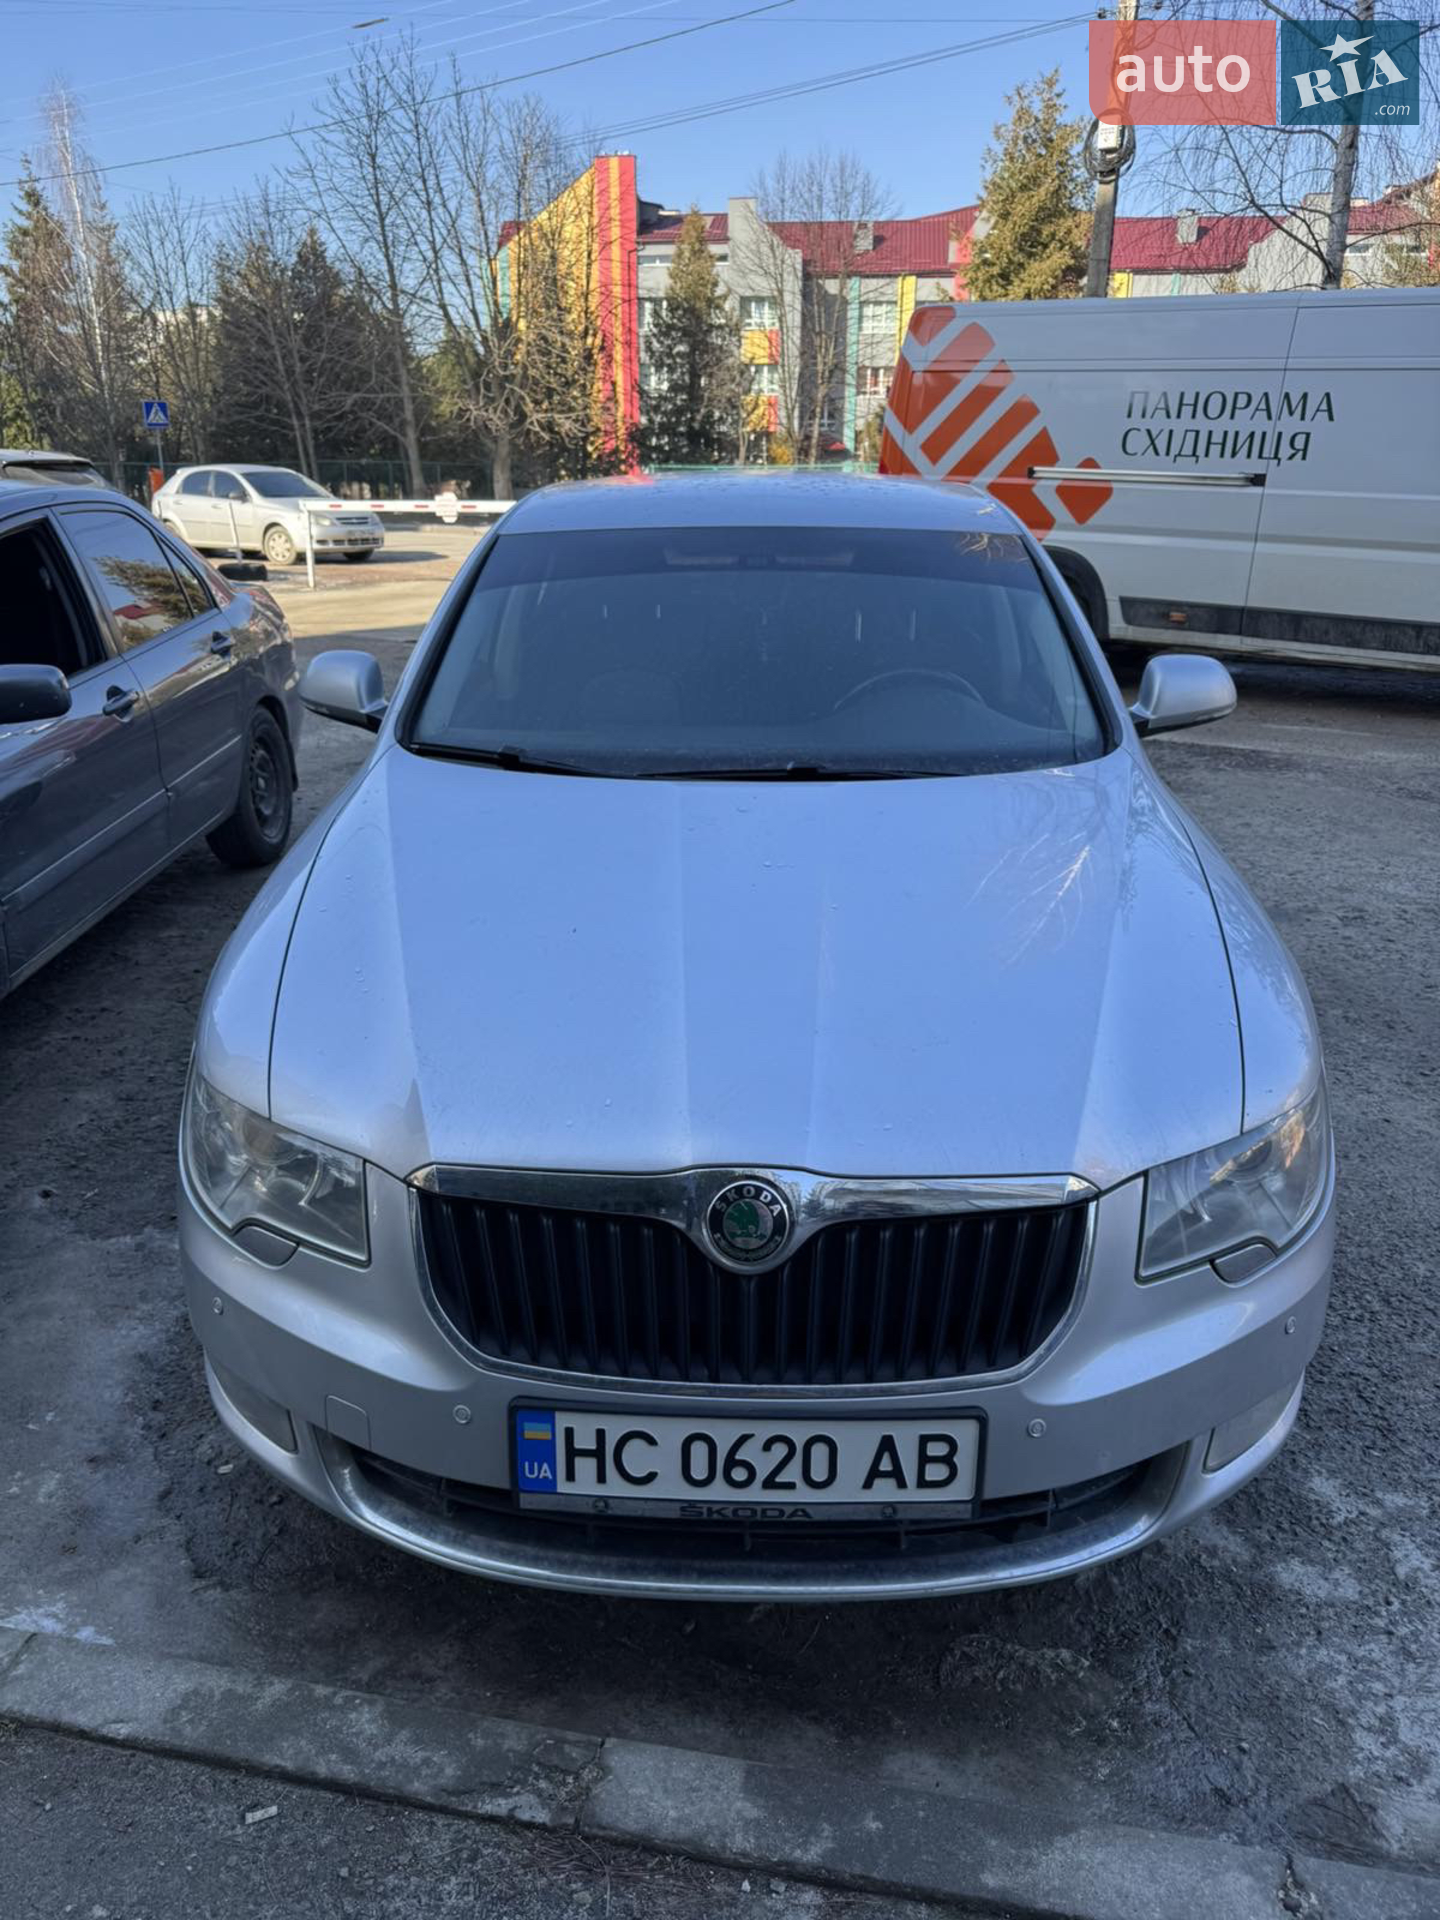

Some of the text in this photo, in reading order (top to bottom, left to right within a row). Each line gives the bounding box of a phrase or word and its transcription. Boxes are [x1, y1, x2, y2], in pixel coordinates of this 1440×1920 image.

[1126, 390, 1335, 422] ПАНОРАМА
[1121, 427, 1312, 467] СХІДНИЦЯ
[524, 1461, 553, 1480] UA
[563, 1426, 960, 1490] HC 0620 AB
